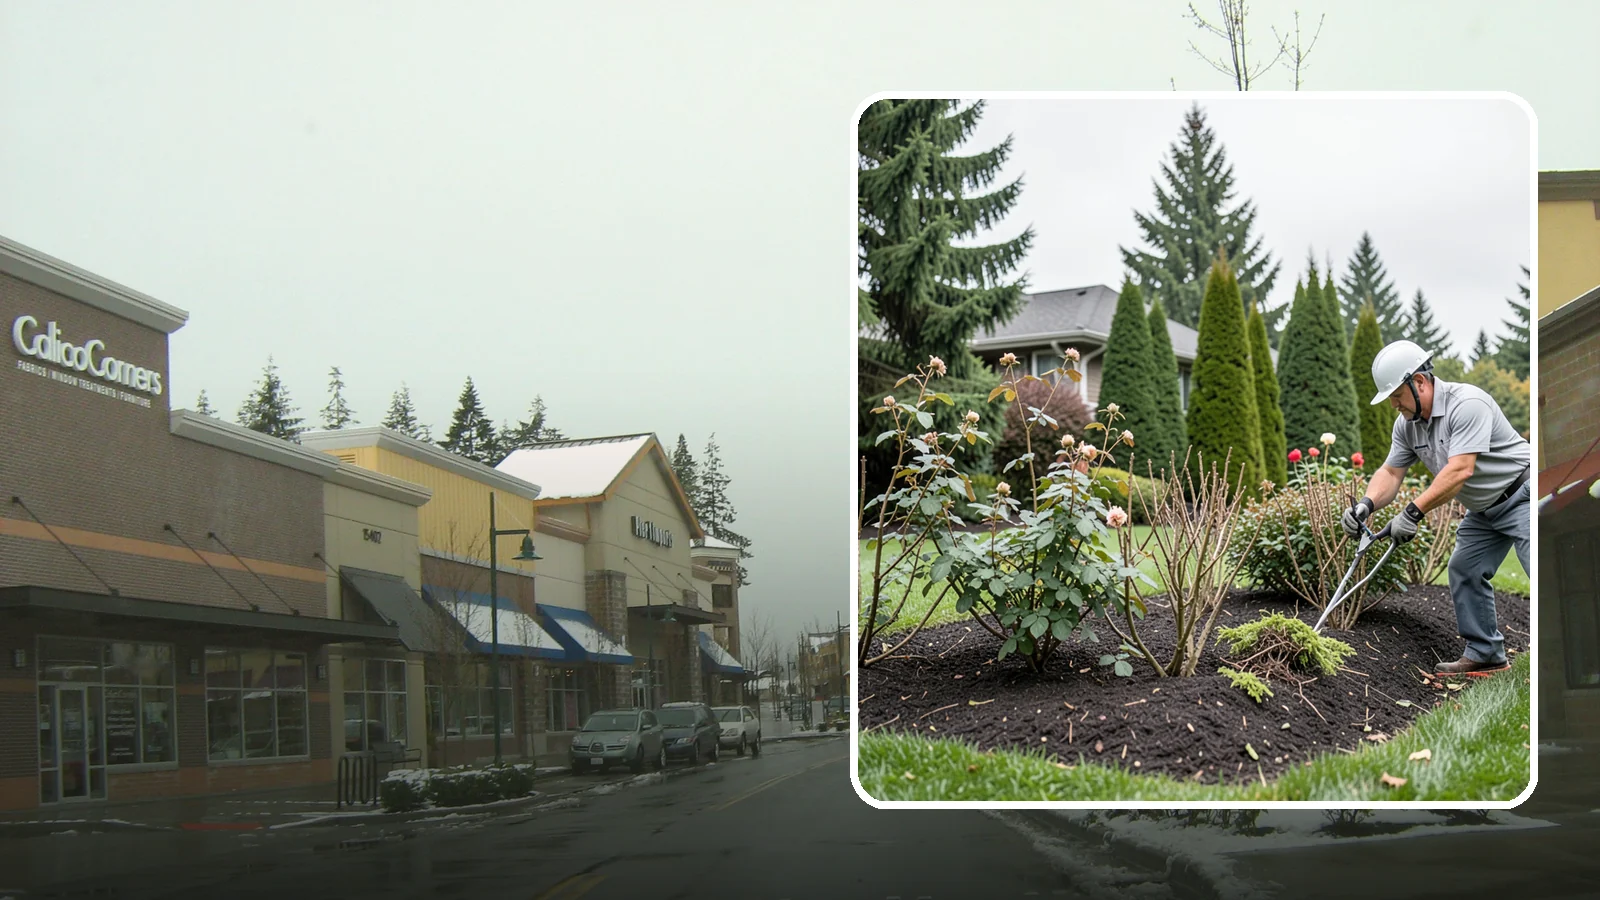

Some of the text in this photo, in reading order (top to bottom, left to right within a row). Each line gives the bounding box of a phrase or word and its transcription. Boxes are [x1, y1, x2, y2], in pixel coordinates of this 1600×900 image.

[17, 360, 152, 408] FABRICS WINDOW TREATMENTS FURNITURE
